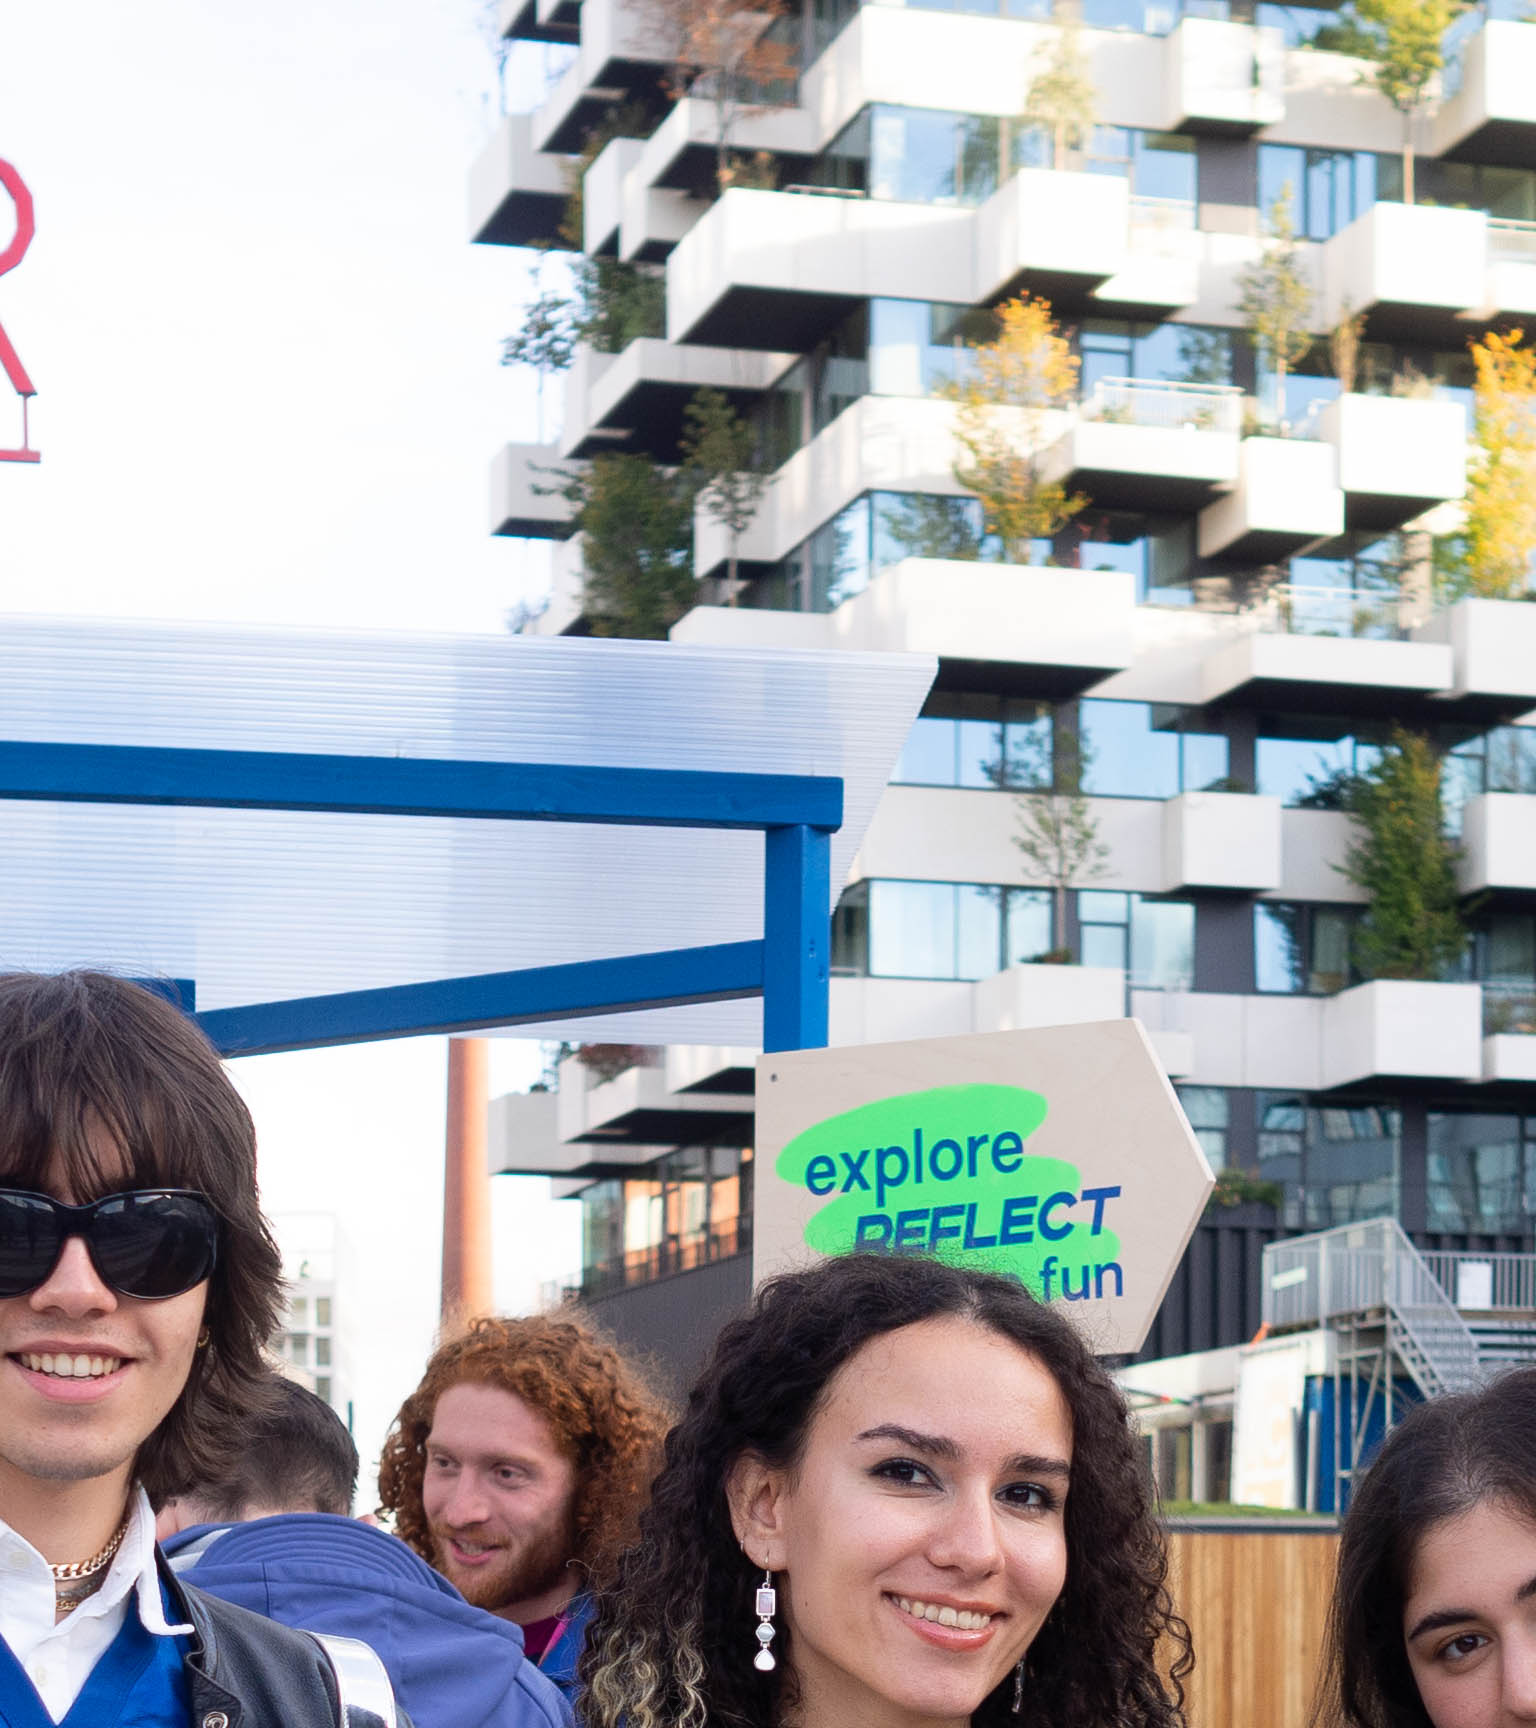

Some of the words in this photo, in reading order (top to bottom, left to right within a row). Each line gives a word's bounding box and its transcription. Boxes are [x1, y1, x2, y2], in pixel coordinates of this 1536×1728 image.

[805, 1128, 1024, 1207] explore
[855, 1186, 1122, 1255] REFLECT
[1039, 1256, 1123, 1302] fun
